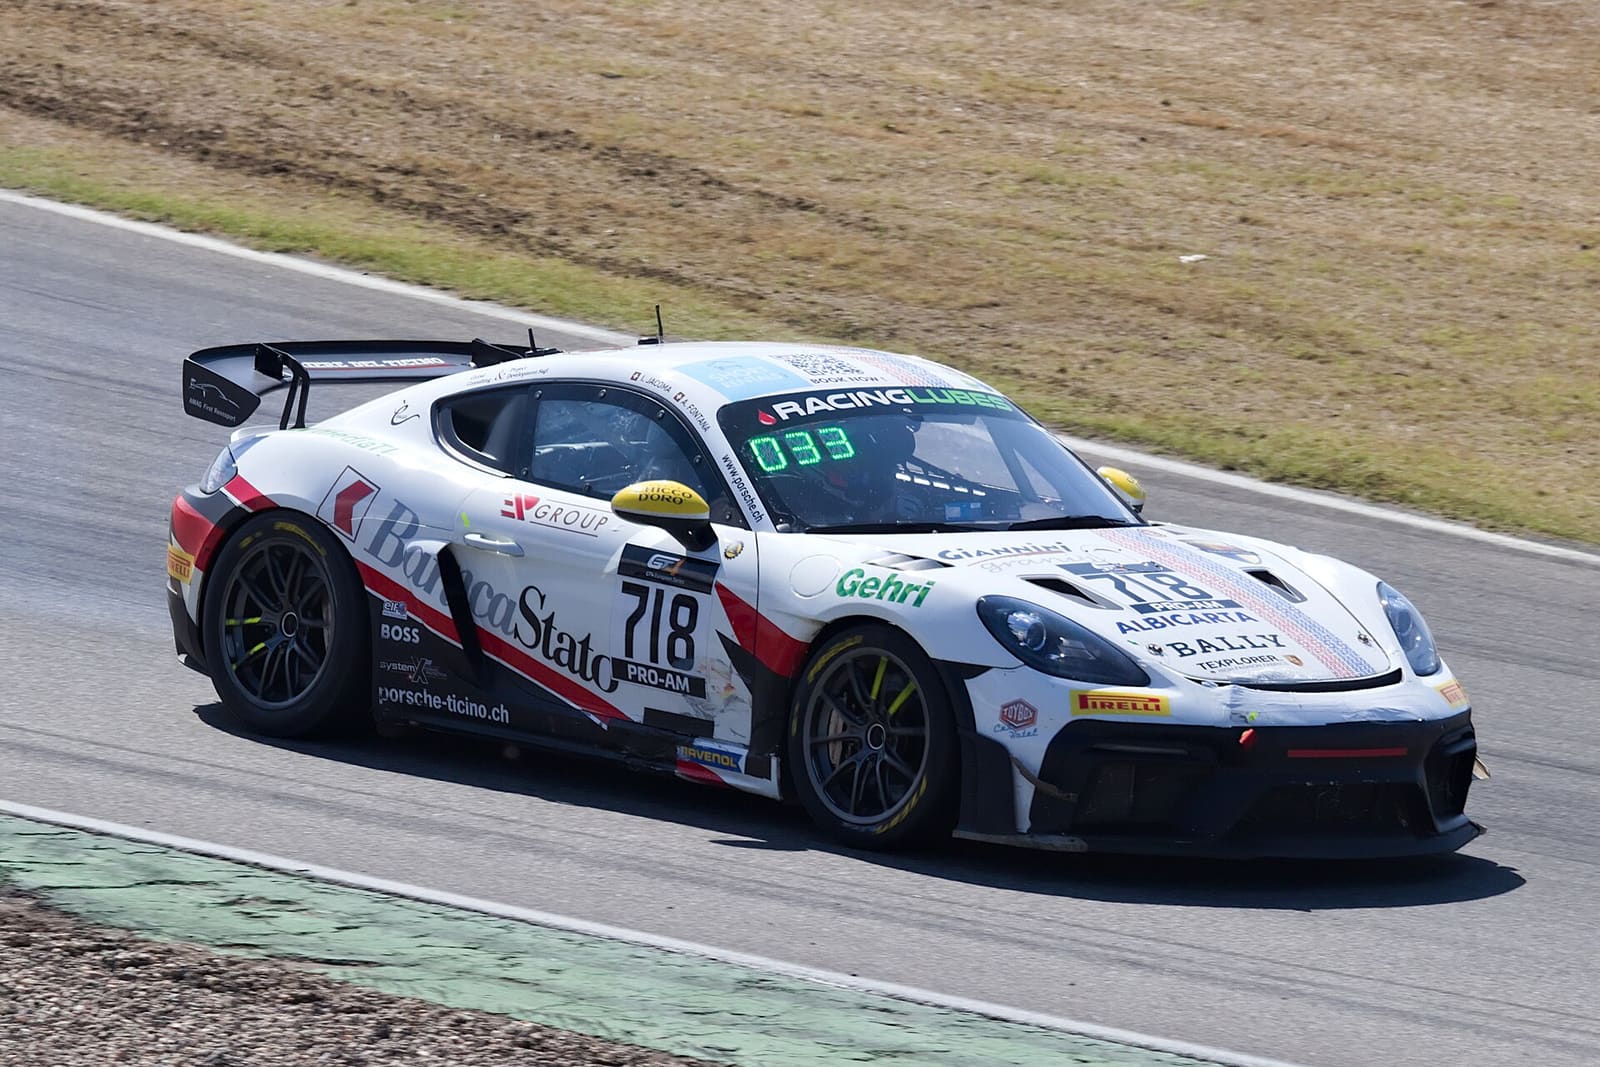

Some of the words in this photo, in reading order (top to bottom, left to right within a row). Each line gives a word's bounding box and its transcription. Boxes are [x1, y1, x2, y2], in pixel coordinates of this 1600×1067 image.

[688, 403, 711, 433] FONTANA
[748, 427, 855, 473] 033
[721, 454, 765, 523] www.porsche.ch
[534, 505, 609, 532] GROUP
[836, 567, 937, 608] Gehri
[1080, 572, 1214, 603] 718
[1154, 600, 1224, 612] PRO-AM
[380, 623, 420, 643] BOSS
[620, 580, 699, 672] 718
[1115, 610, 1259, 635] ALBICARTA
[1165, 634, 1287, 658] BALLY
[1196, 654, 1279, 671] TEXPLORER
[627, 667, 691, 693] PRO-AM
[378, 686, 510, 724] porsche-ticino.ch
[1079, 693, 1161, 712] PIRELLI
